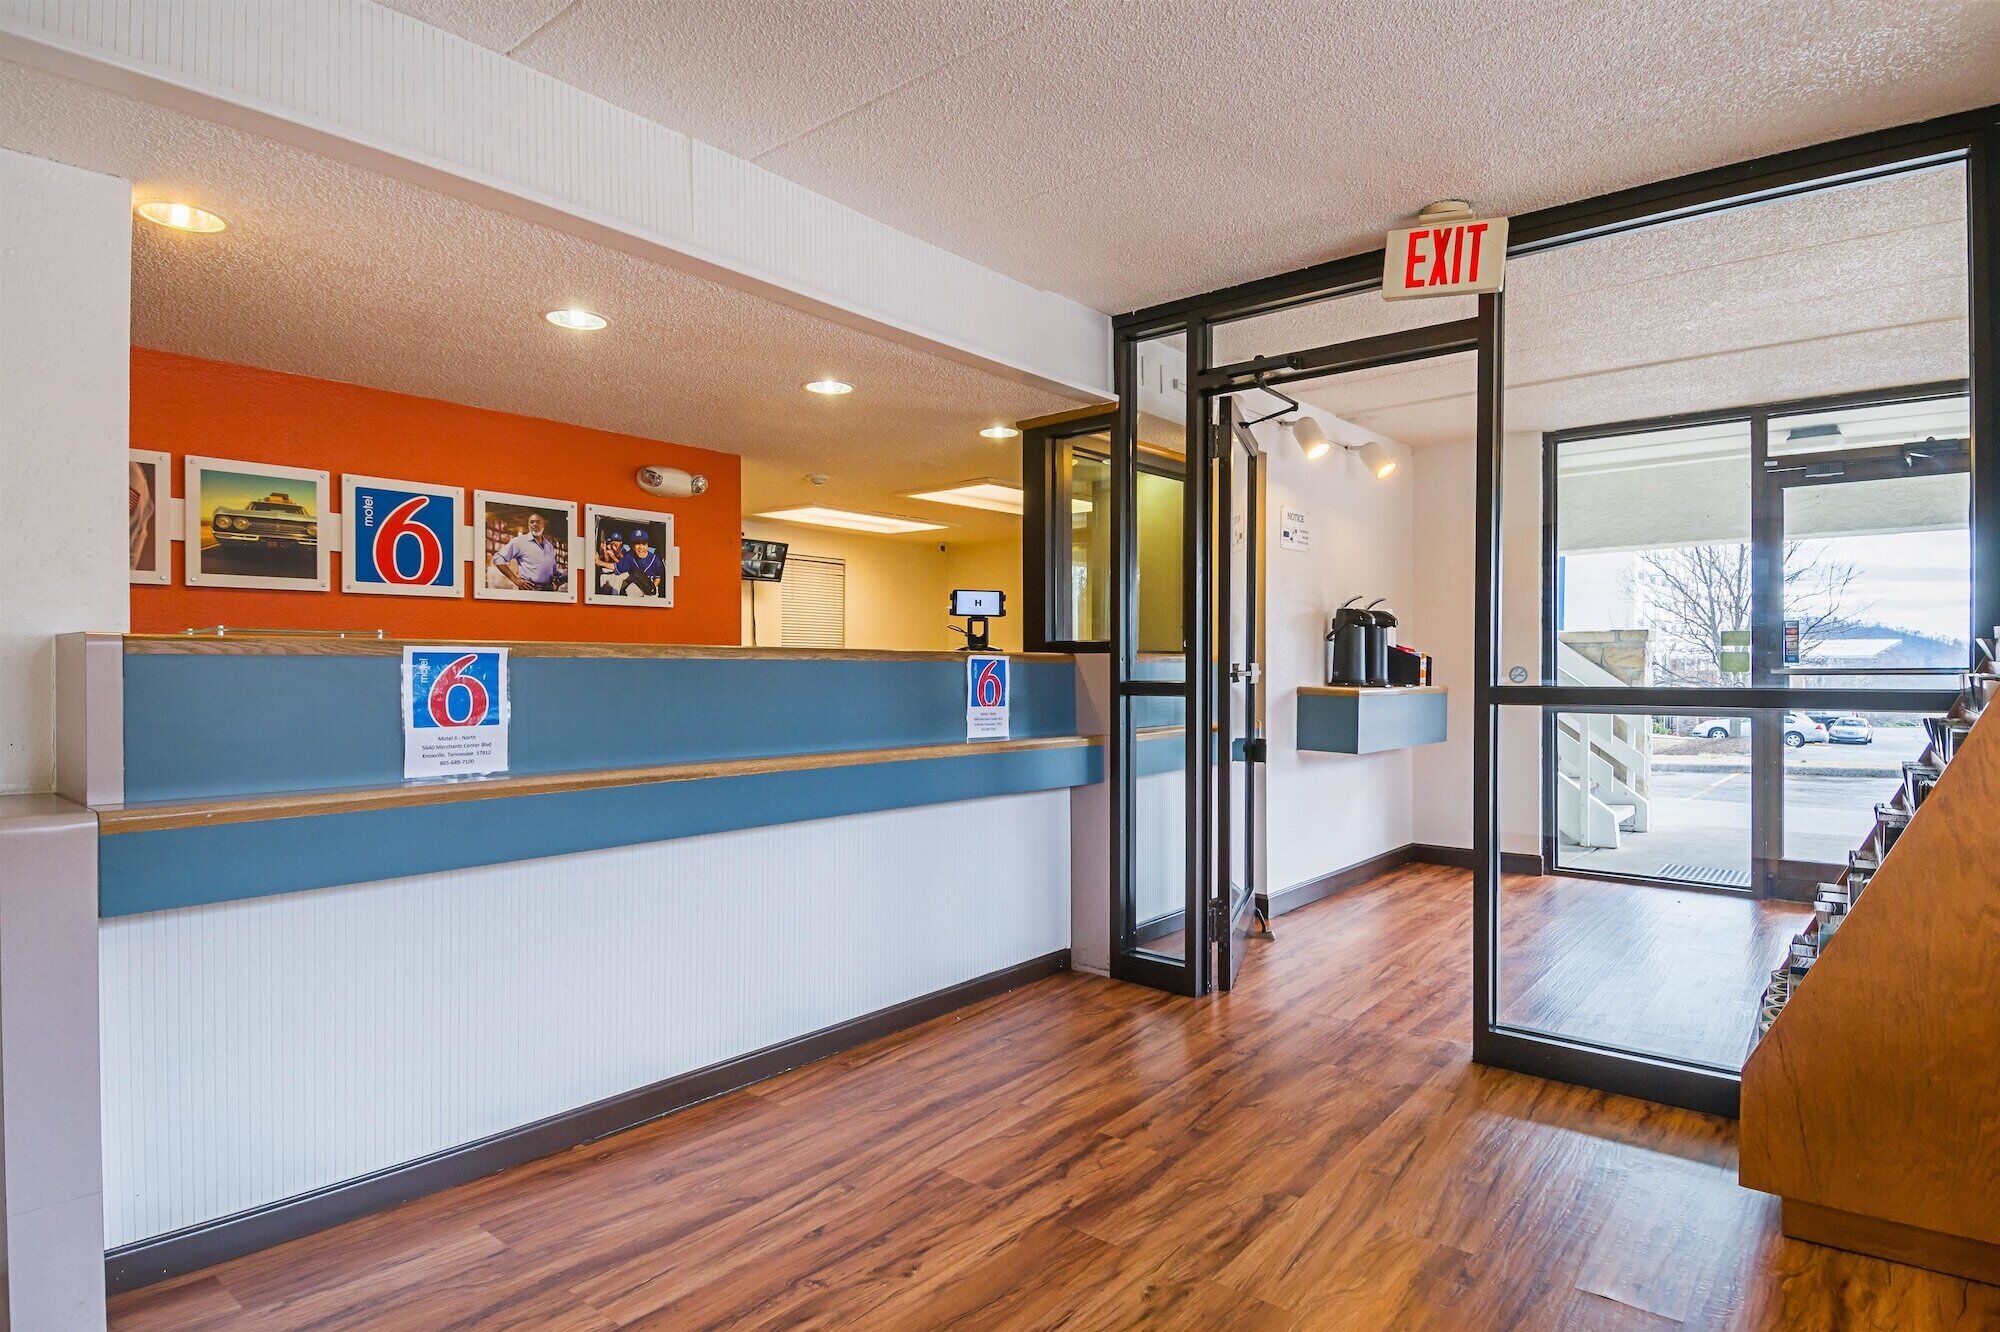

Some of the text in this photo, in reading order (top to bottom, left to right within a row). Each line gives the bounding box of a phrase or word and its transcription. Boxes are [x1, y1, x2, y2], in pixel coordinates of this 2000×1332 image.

[1404, 223, 1489, 289] EXIT
[362, 495, 443, 586] motel 6
[974, 599, 982, 607] H
[419, 653, 489, 728] motel 6
[977, 660, 1003, 708] 6
